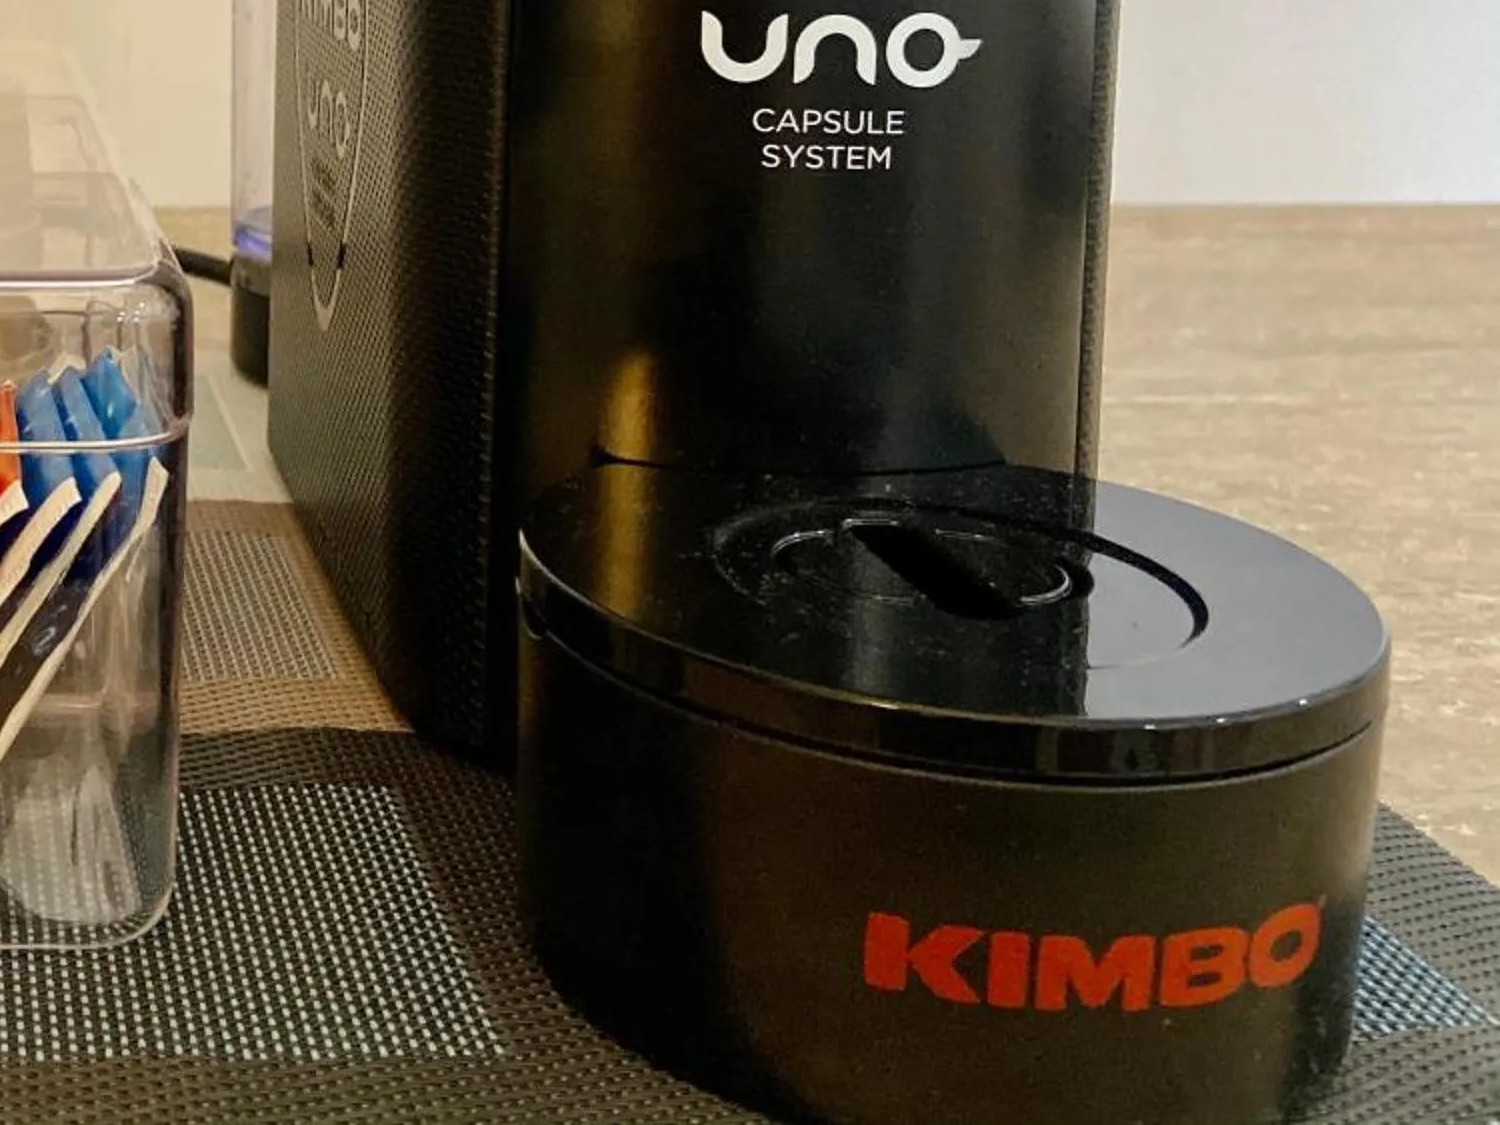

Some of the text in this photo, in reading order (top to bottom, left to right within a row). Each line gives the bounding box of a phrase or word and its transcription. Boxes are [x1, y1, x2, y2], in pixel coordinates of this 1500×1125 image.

[752, 108, 906, 135] CAPSULE
[761, 144, 891, 170] SYSTEM
[863, 902, 1322, 1012] KIMBO
